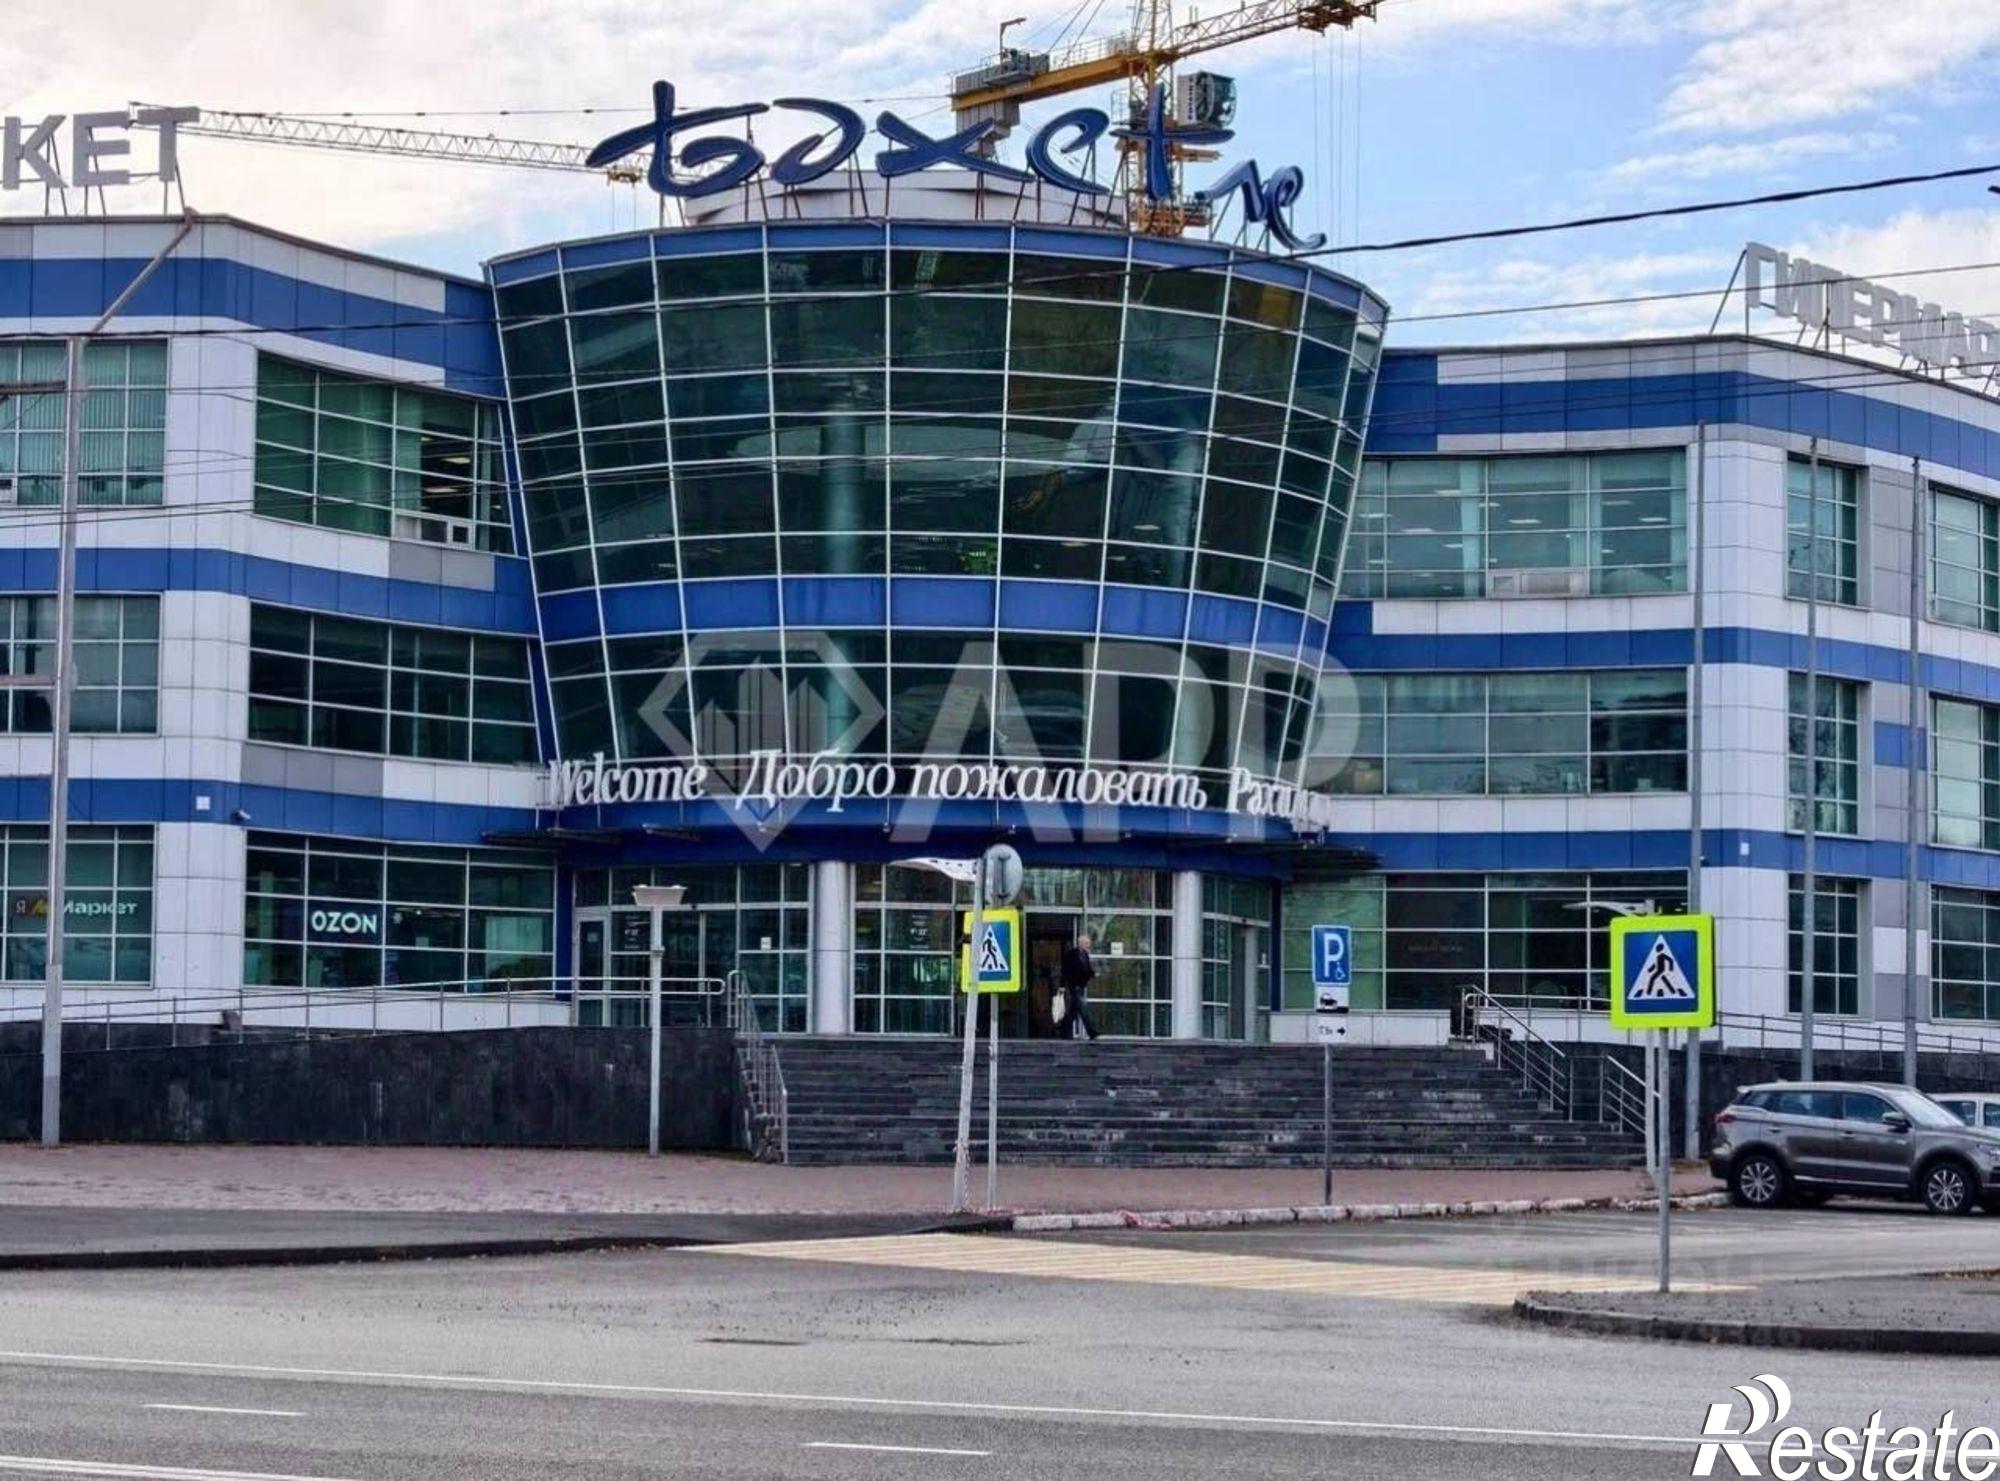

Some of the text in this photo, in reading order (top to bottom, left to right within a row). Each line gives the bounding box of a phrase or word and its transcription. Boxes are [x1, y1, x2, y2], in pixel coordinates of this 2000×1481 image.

[548, 751, 708, 808] Welcome
[735, 748, 896, 812] Добро
[909, 763, 1208, 810] пожаловать
[311, 910, 377, 934] OZON
[1323, 932, 1345, 978] P
